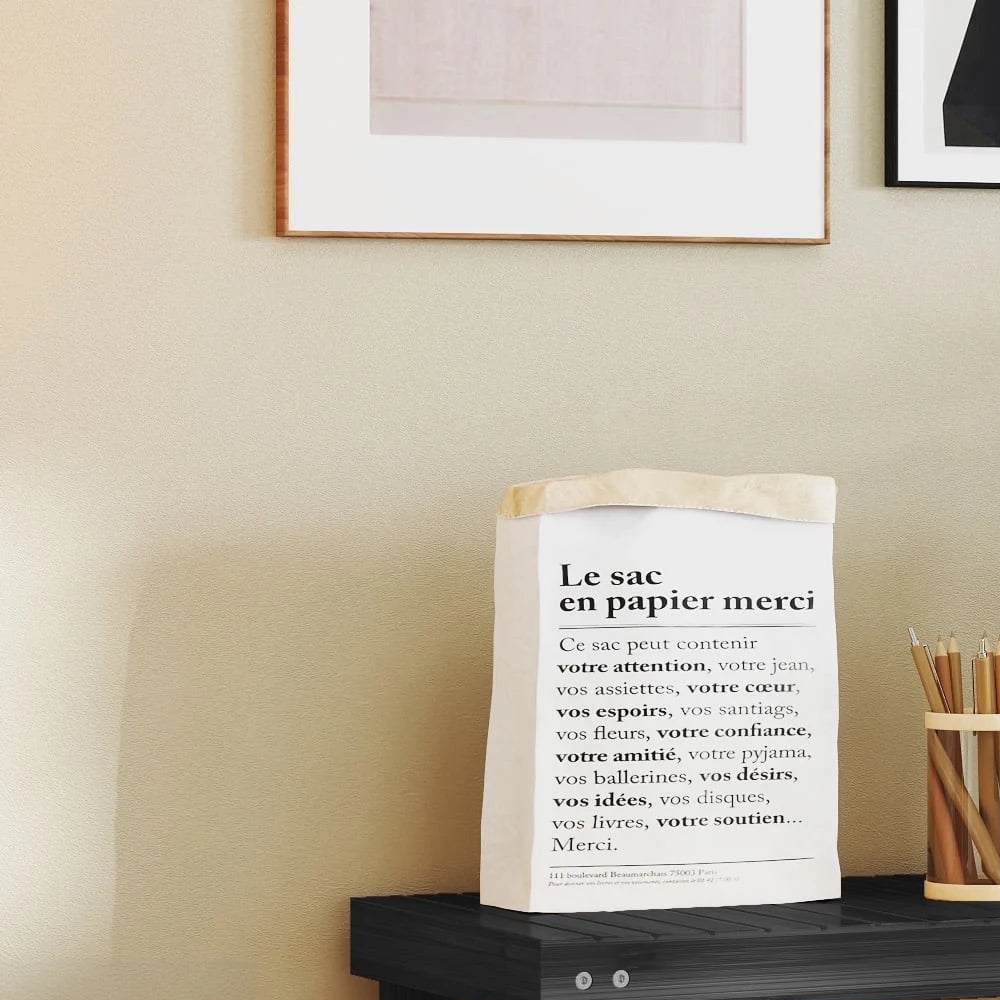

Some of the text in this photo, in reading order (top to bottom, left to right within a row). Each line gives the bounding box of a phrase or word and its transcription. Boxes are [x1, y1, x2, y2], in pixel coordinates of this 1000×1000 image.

[559, 563, 663, 587] Le sac
[559, 589, 815, 620] en papier merci
[559, 636, 758, 656] Ce sac peut contenir
[556, 657, 815, 676] votre attention, votre jean,
[556, 681, 800, 697] vos assiettes, votre cœur,
[555, 701, 799, 723] vos espoirs, vos santiags,
[555, 722, 812, 742] vos fleurs, votre confiance,
[555, 745, 812, 764] votre amitié, votre pyjama,
[554, 766, 798, 785] vos ballerines, vos désirs,
[552, 789, 770, 809] vos idées, vos disques,
[551, 820, 585, 830] vos
[592, 814, 649, 831] livres,
[655, 816, 709, 828] votre
[551, 837, 618, 852] Merci.
[566, 871, 608, 879] boulevard
[610, 870, 668, 878] Beaumarchais
